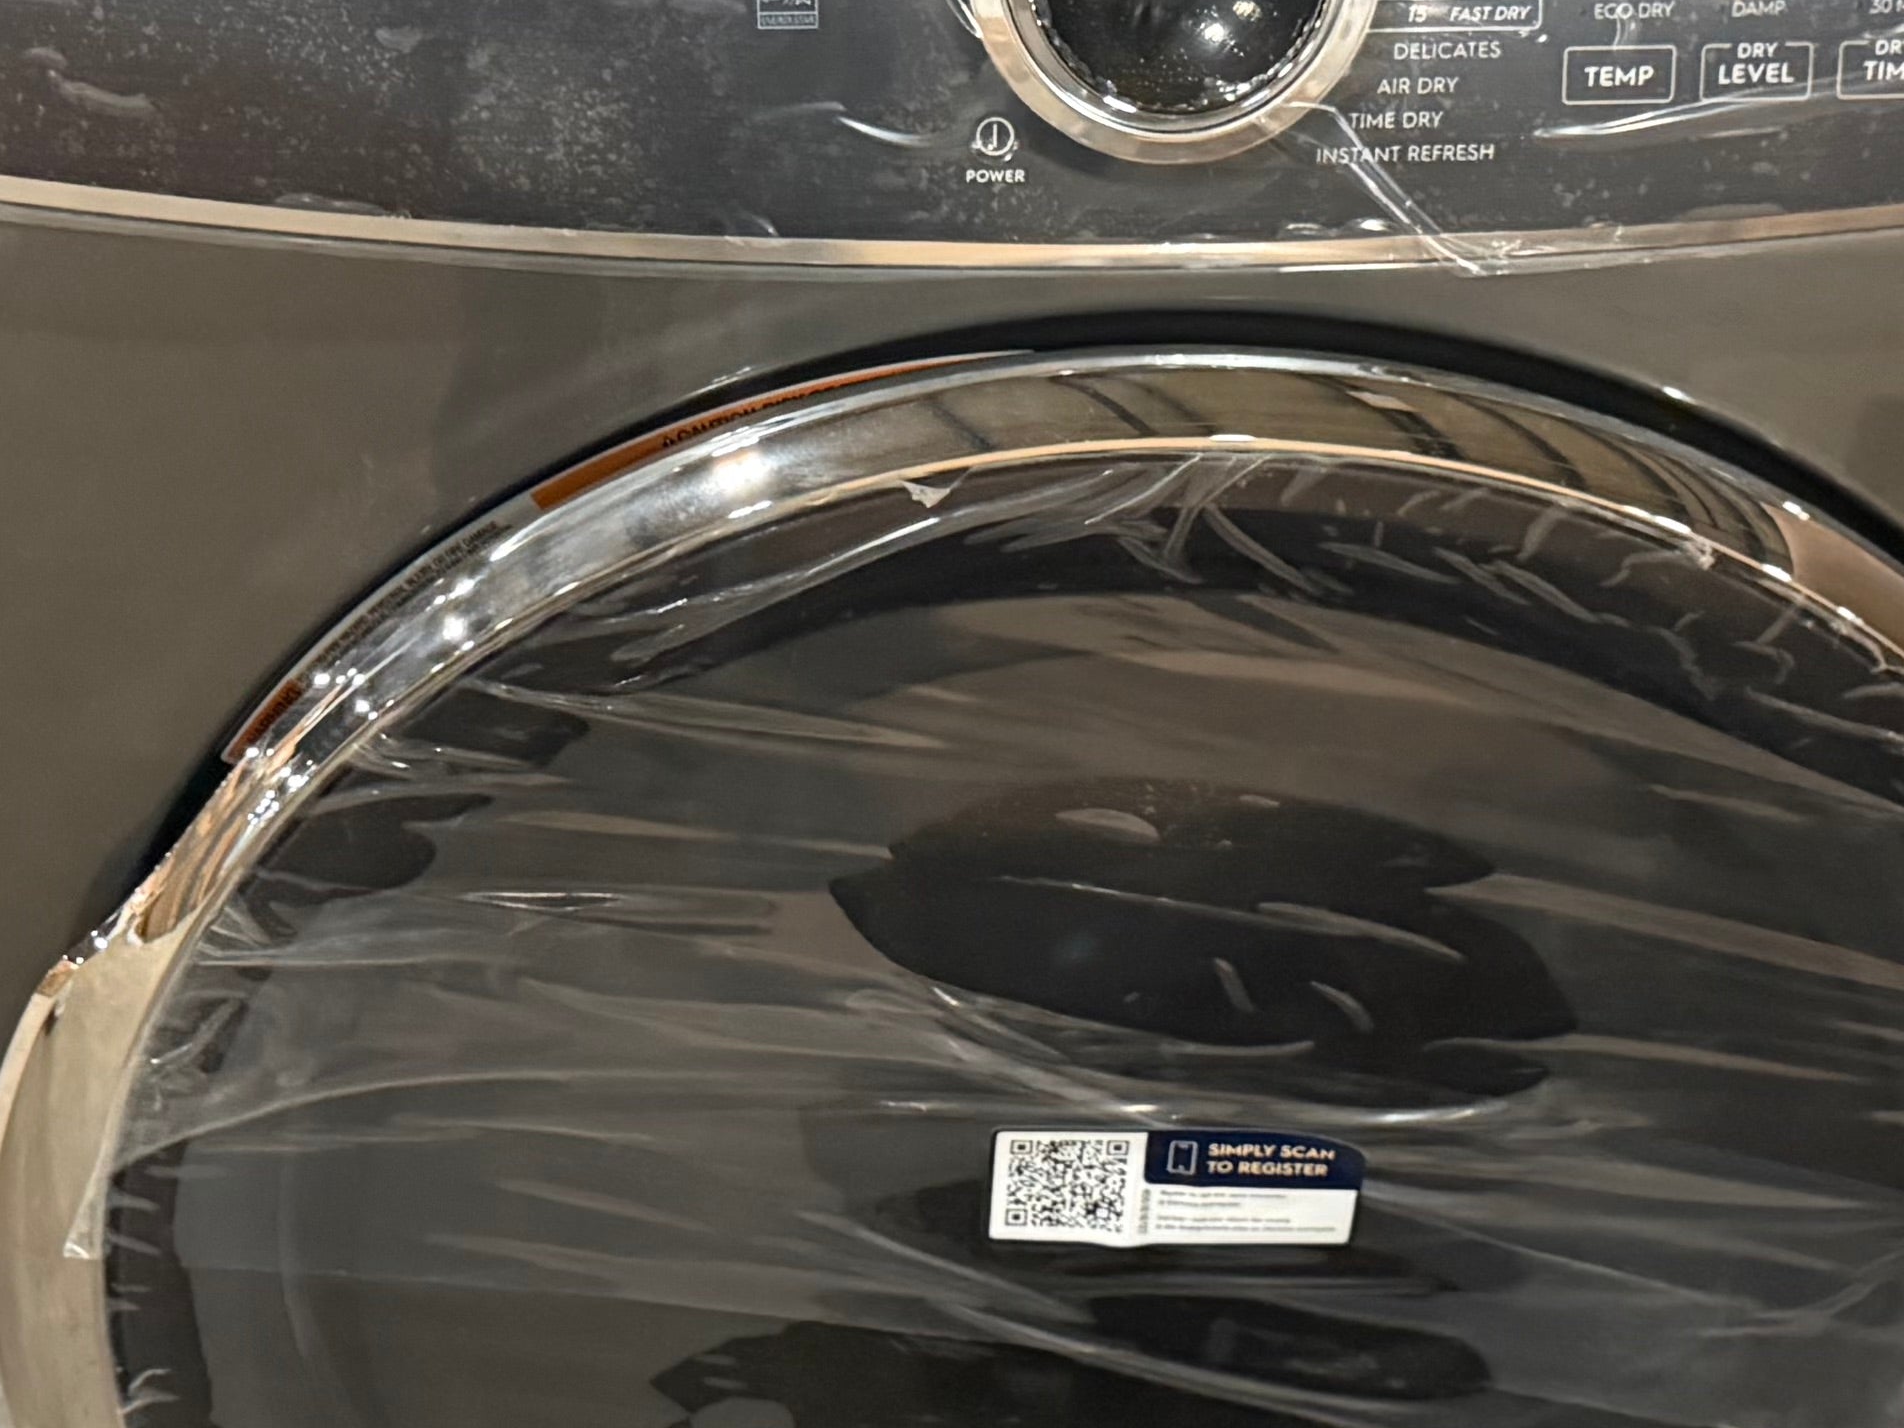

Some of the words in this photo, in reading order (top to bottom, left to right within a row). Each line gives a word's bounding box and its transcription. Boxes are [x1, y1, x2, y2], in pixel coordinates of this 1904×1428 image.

[1450, 5, 1489, 22] FAST
[1494, 3, 1531, 20] DRY
[1594, 2, 1633, 21] ECO
[1637, 1, 1676, 19] DRY
[1731, 0, 1787, 18] DAMP
[1394, 41, 1501, 60] DELICATES
[1737, 43, 1778, 60] DRY
[1584, 65, 1654, 88] TEMP
[1718, 62, 1795, 86] LEVEL
[1376, 78, 1410, 96] AIR
[1417, 76, 1459, 94] DRY
[1349, 112, 1395, 130] TIME
[1402, 110, 1444, 128] DRY
[1316, 145, 1400, 164] INSTANT
[1408, 144, 1495, 162] REFRESH
[966, 169, 1026, 184] POWER
[1208, 1142, 1276, 1158] SIMPLY
[1280, 1145, 1336, 1161] SCAN
[1206, 1160, 1234, 1174] TO
[1237, 1162, 1328, 1177] REGISTER
